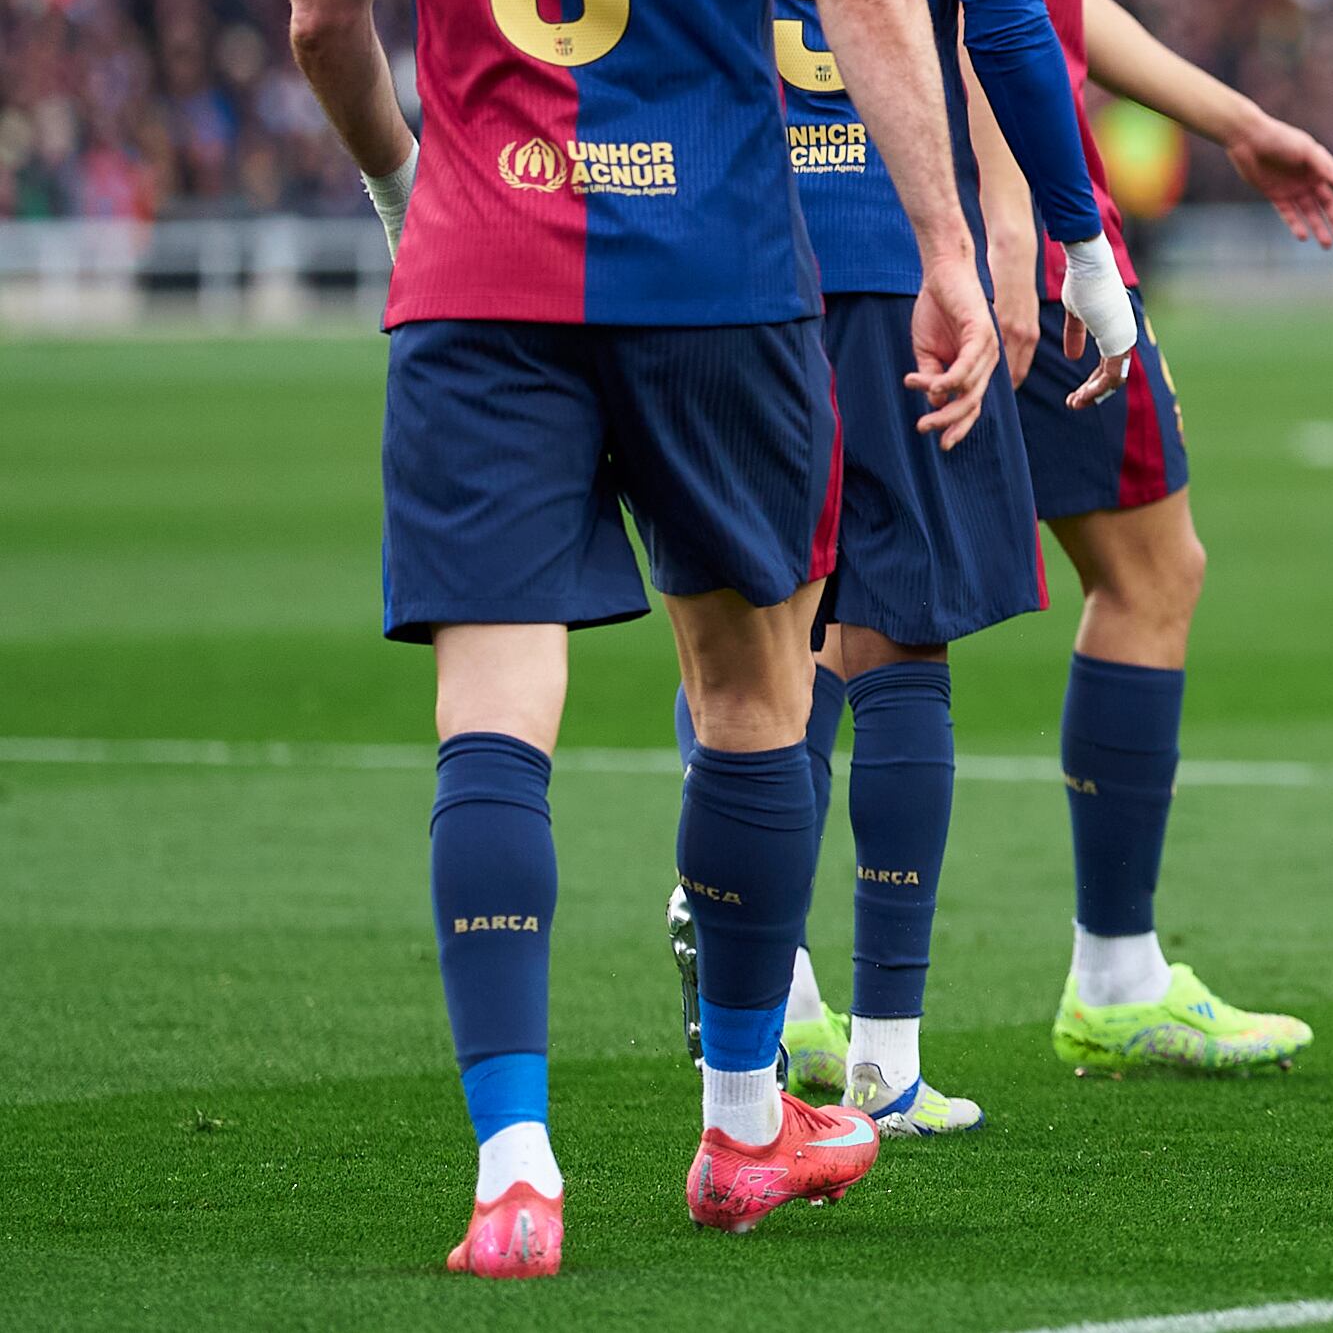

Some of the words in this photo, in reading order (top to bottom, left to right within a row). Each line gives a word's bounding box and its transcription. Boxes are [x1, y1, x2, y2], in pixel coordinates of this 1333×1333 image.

[786, 123, 867, 146] NHCR
[566, 140, 674, 165] UNHCR
[570, 161, 677, 186] ACNUR
[678, 872, 742, 905] ARÇA
